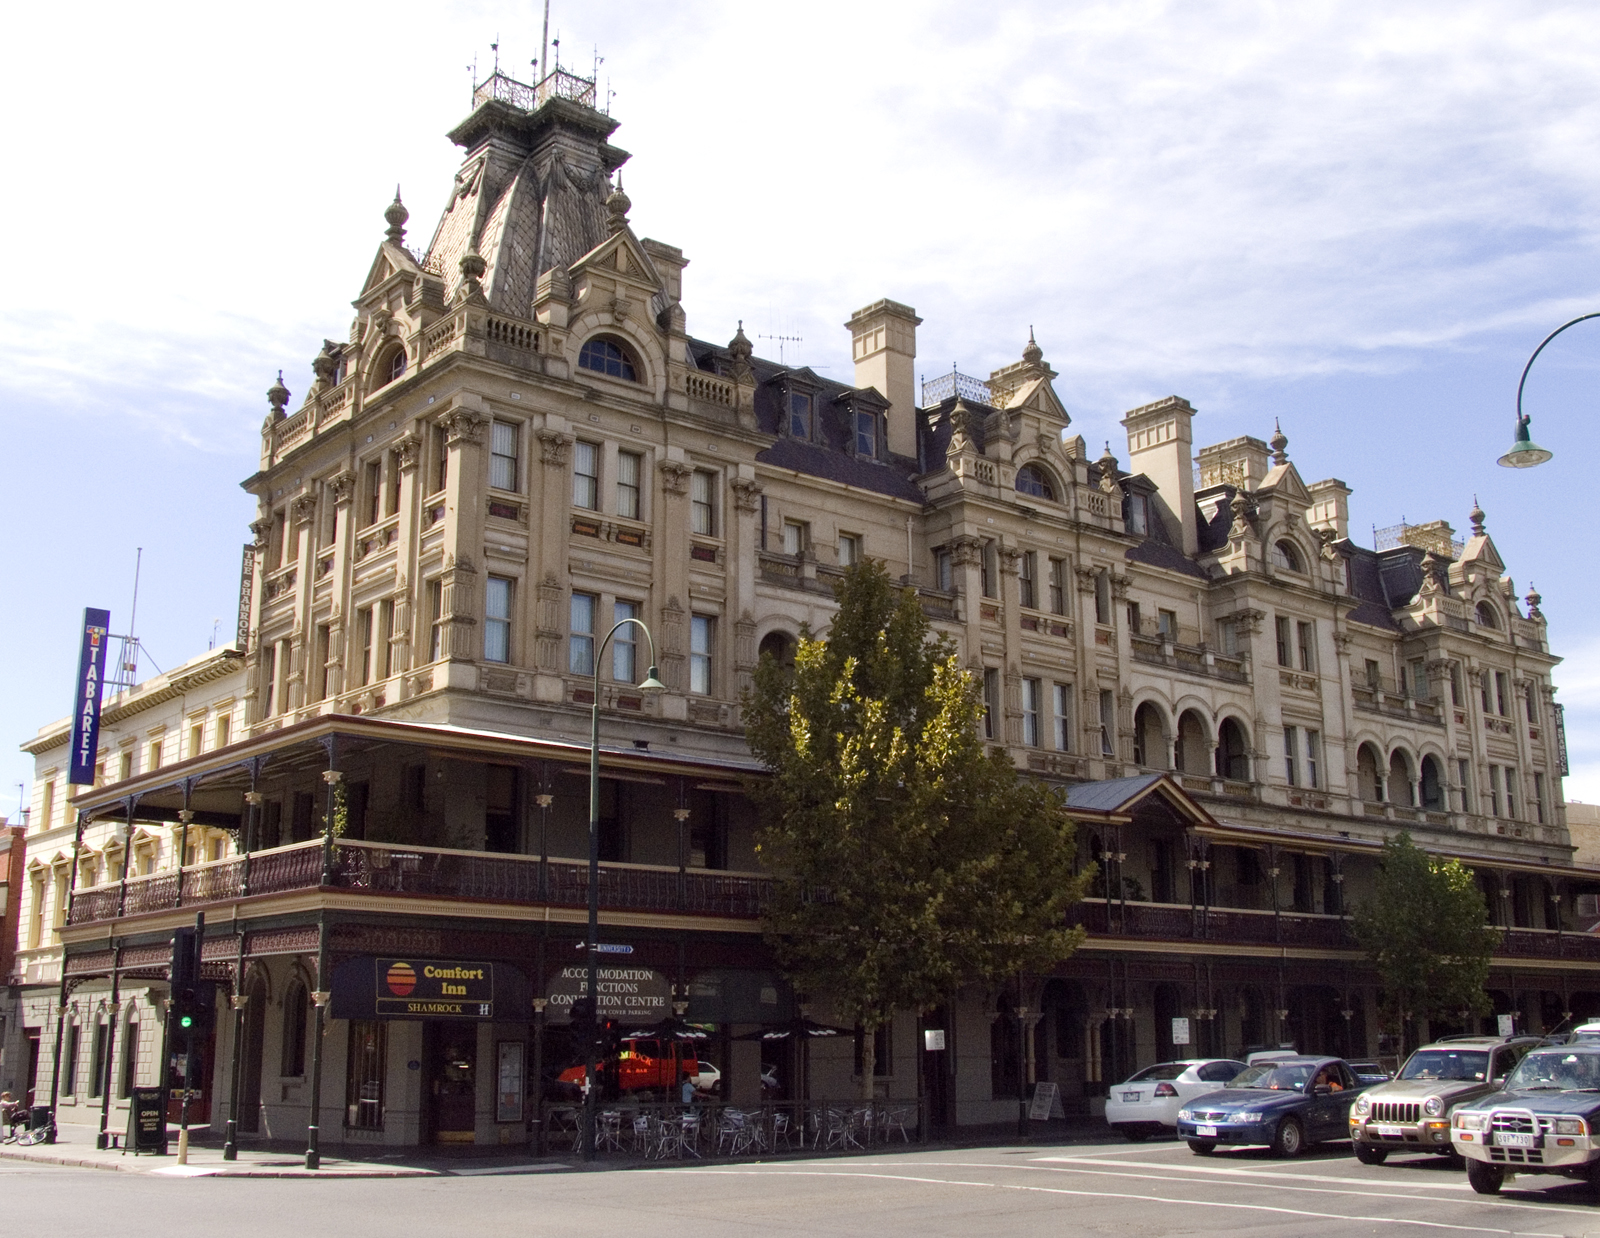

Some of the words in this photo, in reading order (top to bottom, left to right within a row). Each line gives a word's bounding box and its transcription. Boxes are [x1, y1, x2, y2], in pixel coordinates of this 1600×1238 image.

[243, 550, 254, 575] THE
[237, 580, 251, 645] SHAMROCK
[80, 647, 99, 766] TABARET
[1558, 728, 1568, 772] SHAMROCK
[600, 945, 626, 953] UNIVERSITY
[423, 965, 484, 980] Comfort
[561, 967, 653, 980] ACCOMODATION
[441, 982, 467, 995] Inn
[550, 994, 622, 1006] CONTION
[624, 995, 665, 1007] CENTRE
[407, 1003, 462, 1013] SHAMROCK
